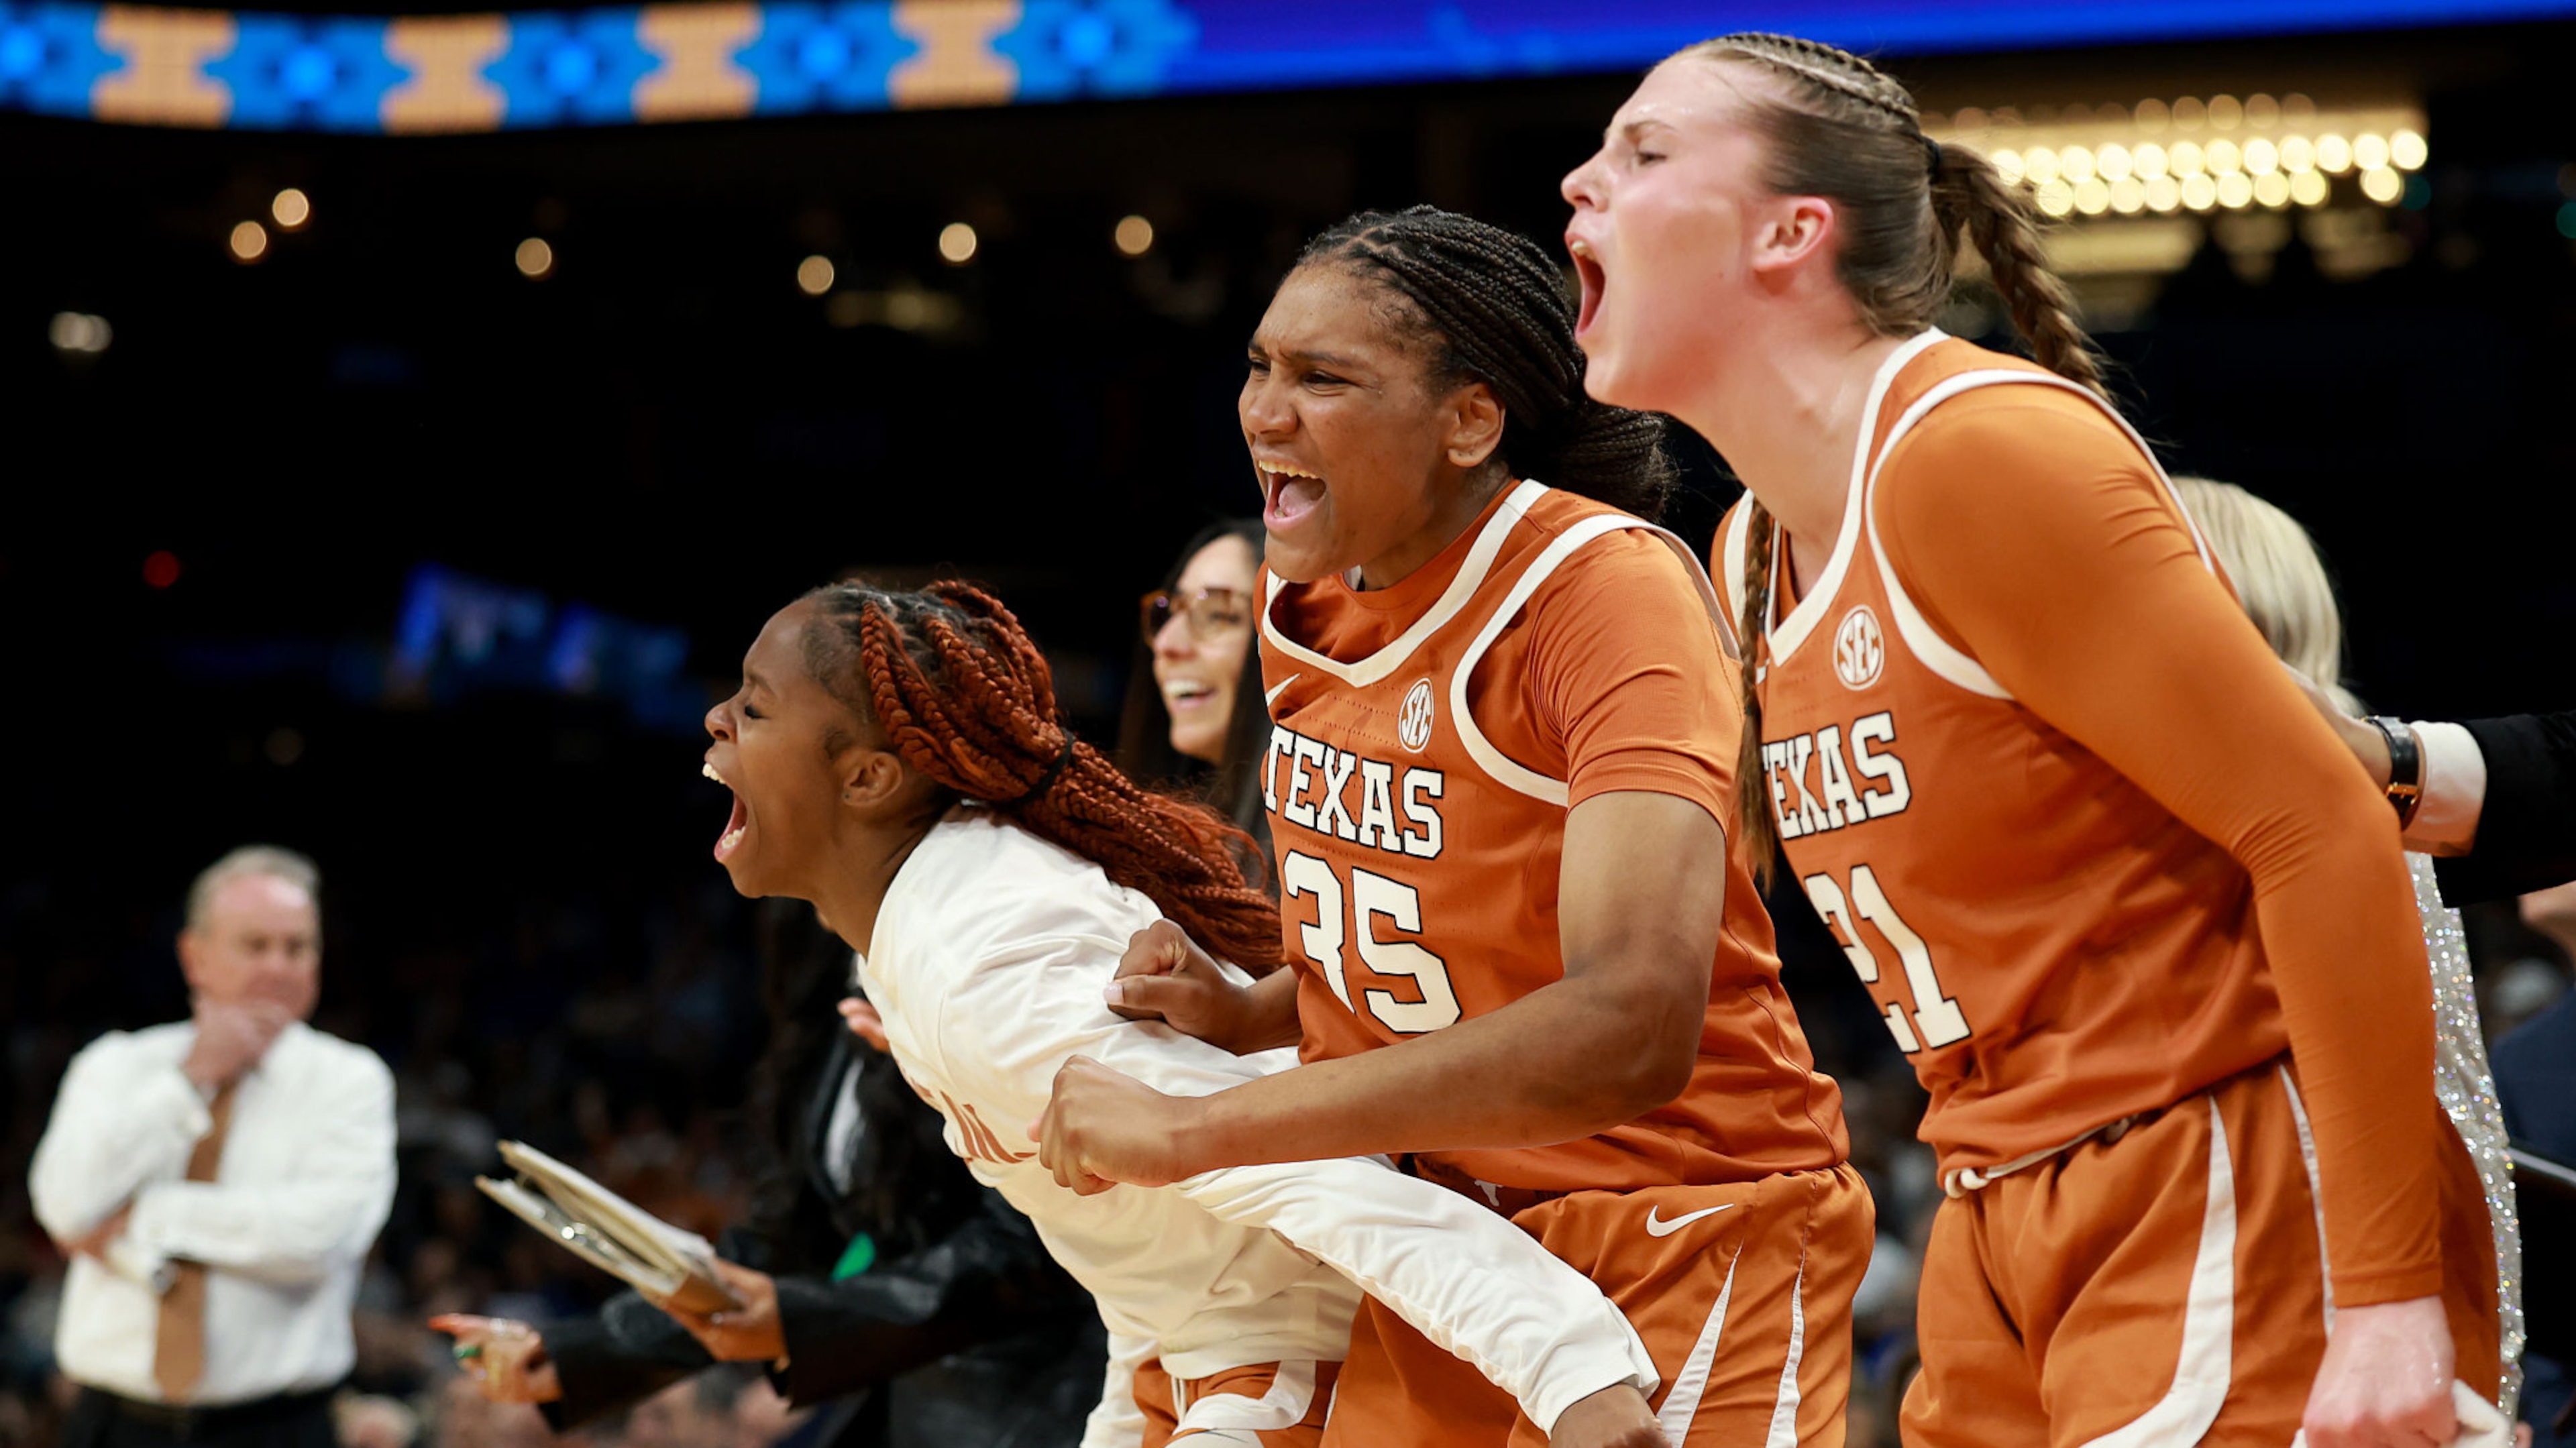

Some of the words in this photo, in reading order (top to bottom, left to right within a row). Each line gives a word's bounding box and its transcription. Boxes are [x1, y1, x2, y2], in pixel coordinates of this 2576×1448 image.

[1401, 683, 1432, 747] SEC
[1838, 611, 1880, 683] SEC
[1265, 724, 1444, 860] TEXAS
[1284, 849, 1462, 1034] 35
[1804, 862, 1973, 1053] 21
